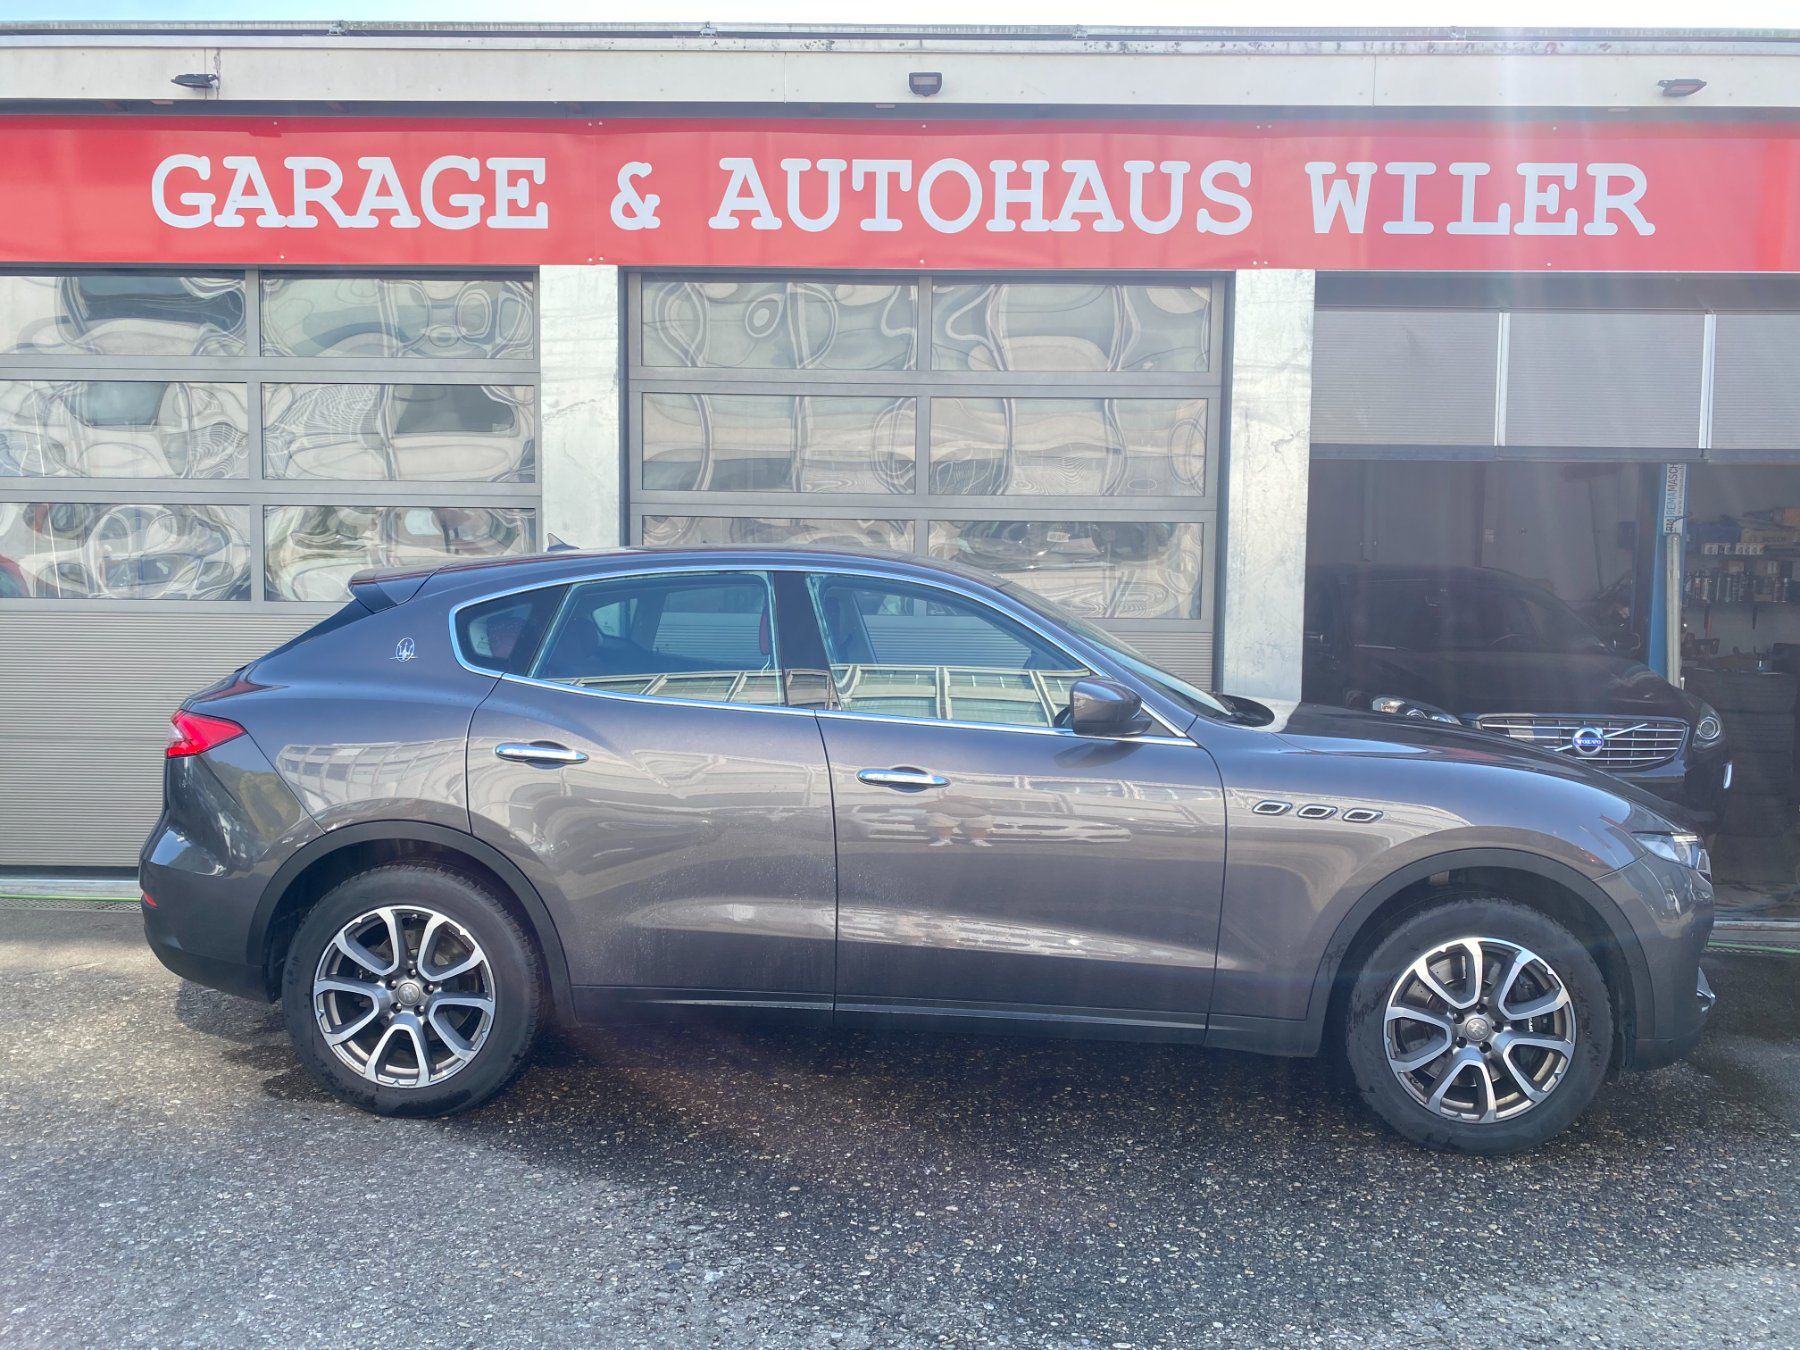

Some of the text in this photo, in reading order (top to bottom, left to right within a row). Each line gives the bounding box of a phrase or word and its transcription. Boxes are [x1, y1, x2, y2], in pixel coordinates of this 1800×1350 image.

[151, 154, 1657, 236] GARAGE & AUTOHAUS WILER
